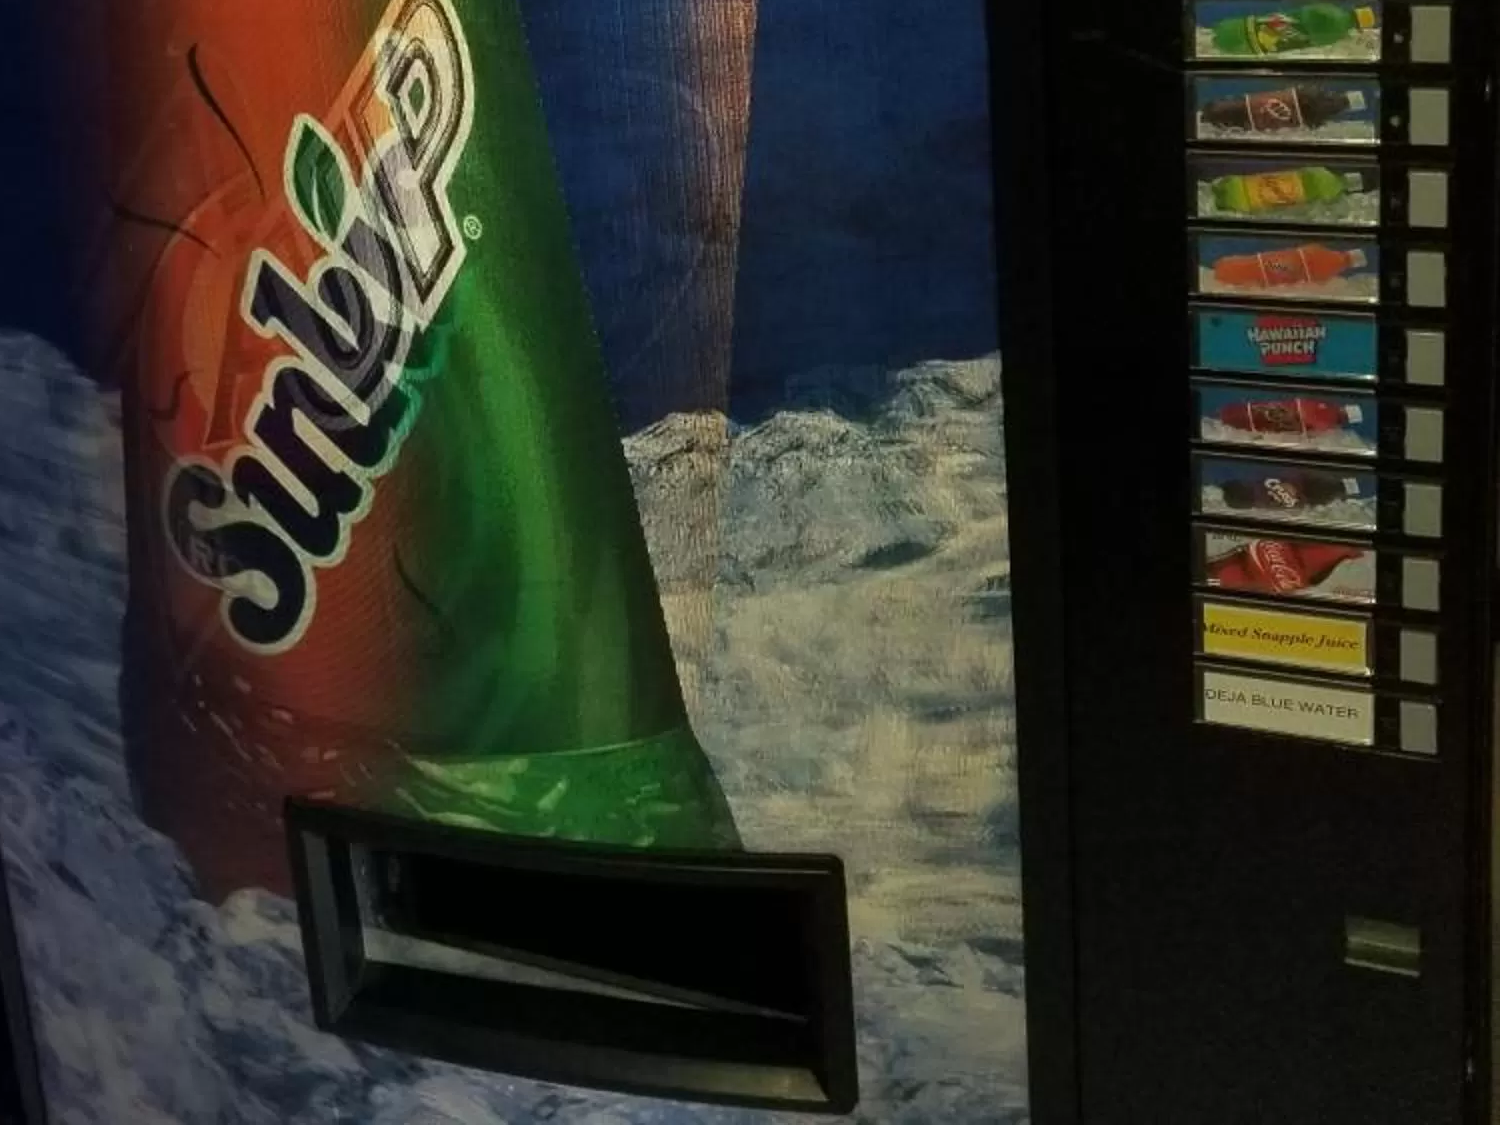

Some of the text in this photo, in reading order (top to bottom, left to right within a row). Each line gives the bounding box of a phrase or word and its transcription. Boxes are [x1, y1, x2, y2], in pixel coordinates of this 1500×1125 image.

[1246, 323, 1327, 346] HAWAIIAN
[1259, 340, 1316, 357] PUNCH
[1202, 621, 1360, 651] Mixed Snapple Juice
[1204, 687, 1360, 720] DEJA BLUE WATER
